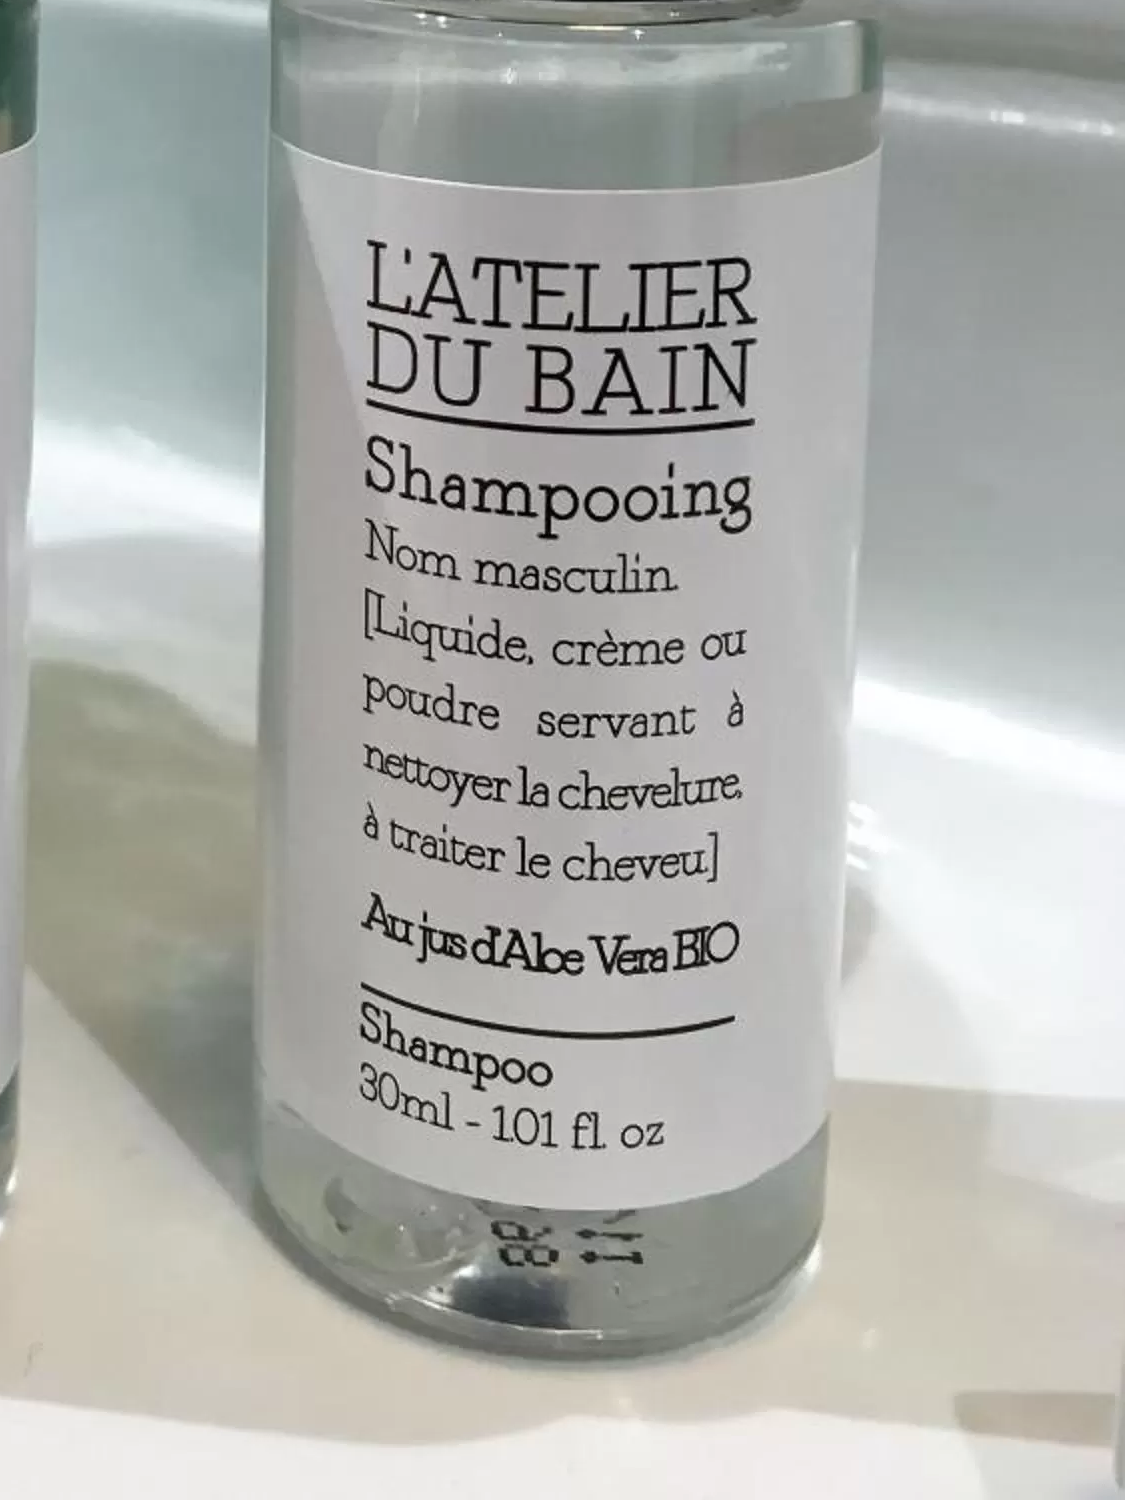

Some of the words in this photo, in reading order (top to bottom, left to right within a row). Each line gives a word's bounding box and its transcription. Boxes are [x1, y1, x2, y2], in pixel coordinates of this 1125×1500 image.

[365, 238, 759, 336] L'ATELIER
[365, 319, 493, 408] DU
[524, 337, 759, 417] BAIN
[364, 433, 753, 541] Shampooing
[363, 517, 463, 582] Nom
[551, 628, 686, 668] crème
[699, 629, 749, 662] ou
[362, 672, 501, 732] poudre
[536, 704, 698, 740] servant
[726, 688, 745, 729] à
[362, 742, 513, 809] nettoyer
[515, 764, 551, 809] la
[557, 765, 744, 812] chevelure,
[362, 799, 380, 842] à
[388, 817, 508, 873] traiter
[514, 835, 552, 880] le
[359, 891, 416, 948] Au
[415, 909, 469, 965] jus
[586, 933, 669, 977] Vera
[671, 919, 741, 972] BIO
[357, 1000, 555, 1093] Shampoo
[358, 1060, 456, 1132] 30ml
[619, 1121, 665, 1150] oz
